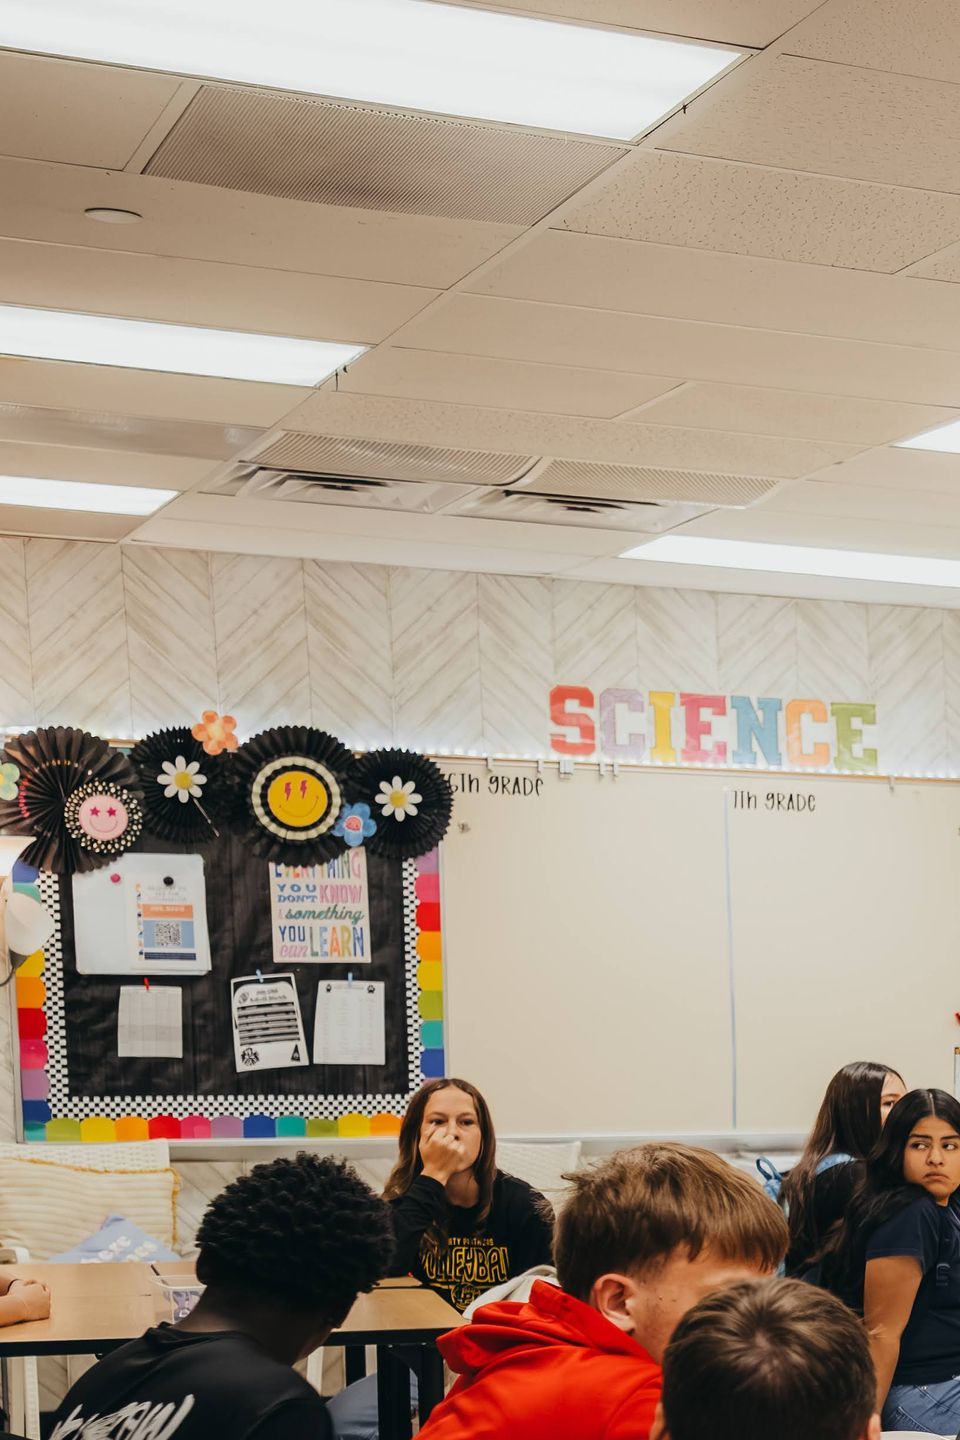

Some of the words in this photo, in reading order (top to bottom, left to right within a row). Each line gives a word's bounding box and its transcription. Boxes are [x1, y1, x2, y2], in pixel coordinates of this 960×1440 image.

[550, 685, 877, 769] SCIENCE
[277, 883, 317, 893] YOU
[320, 885, 362, 904] KNOW
[285, 904, 364, 925] something
[279, 925, 306, 942] YOU
[309, 925, 365, 957] LEARN
